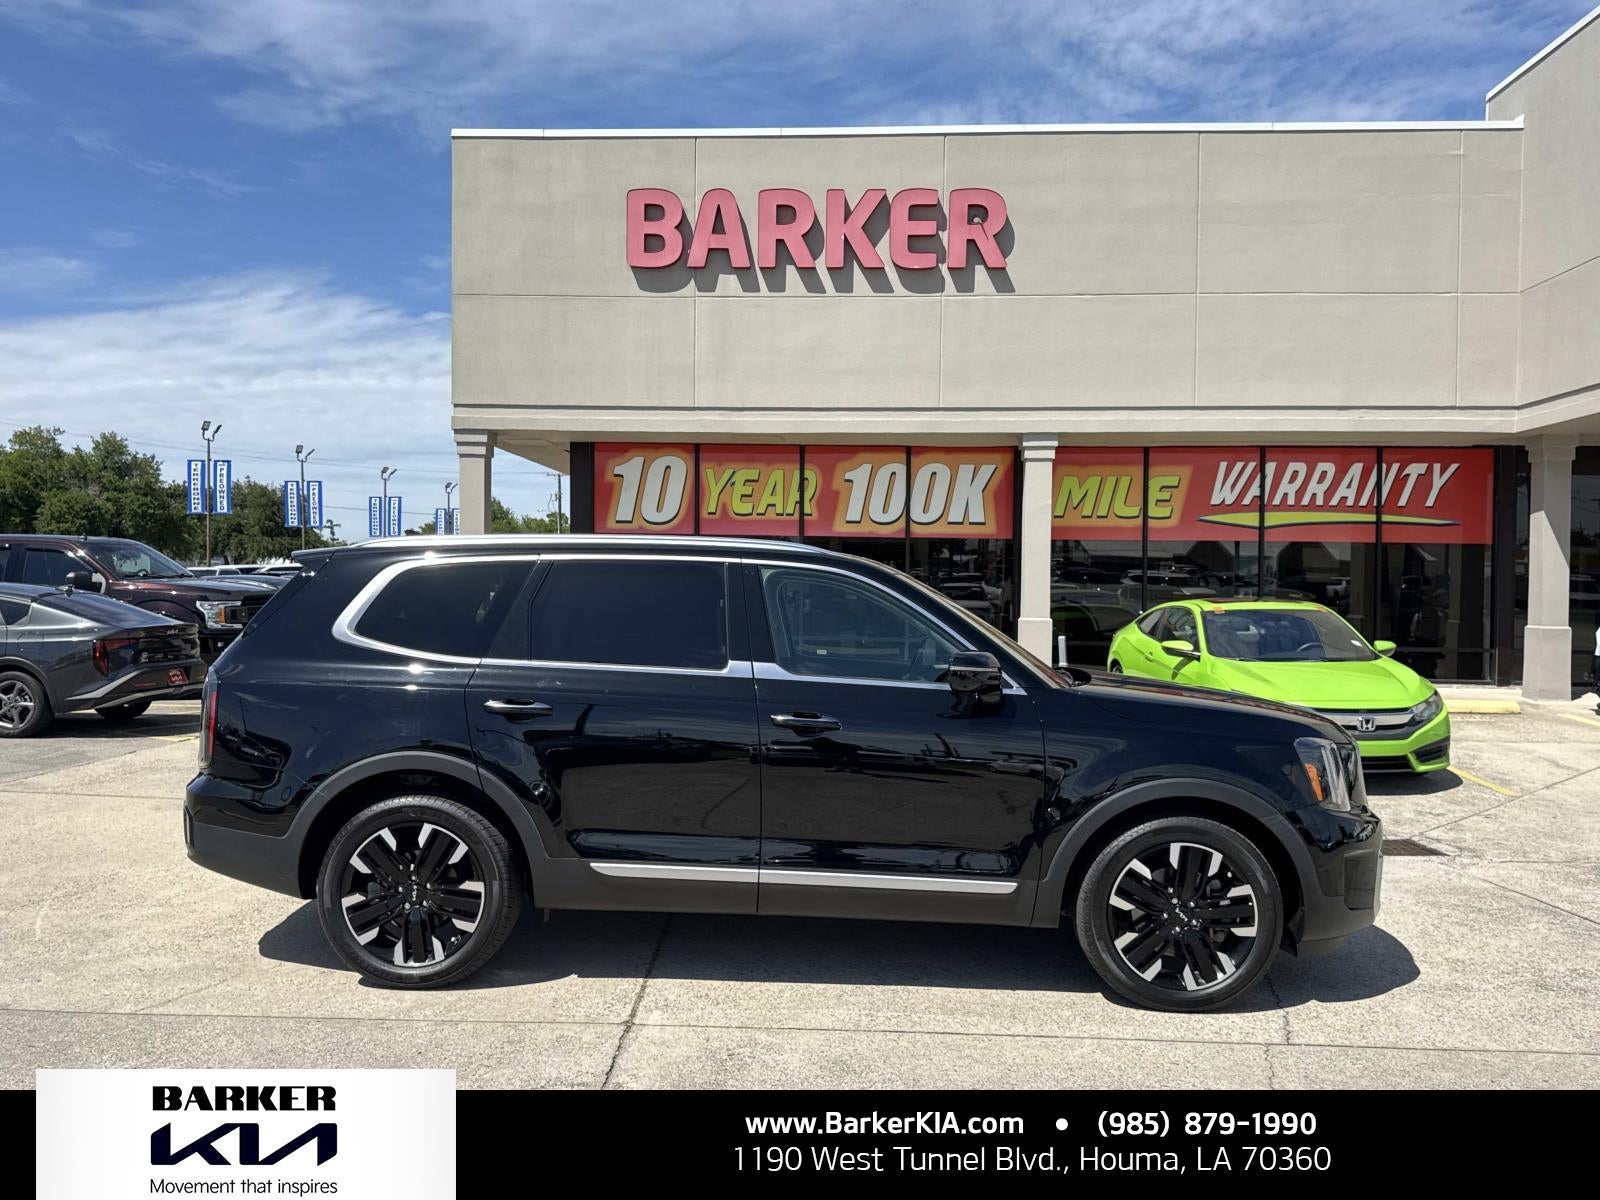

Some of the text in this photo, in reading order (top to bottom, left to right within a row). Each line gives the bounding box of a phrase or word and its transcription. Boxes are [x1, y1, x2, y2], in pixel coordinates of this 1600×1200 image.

[626, 188, 1008, 269] BARKER
[192, 462, 200, 511] TERREBONNE
[218, 467, 226, 511] PREOWNED
[613, 456, 1461, 525] 10 YEAR 100K MILE WARRANTY
